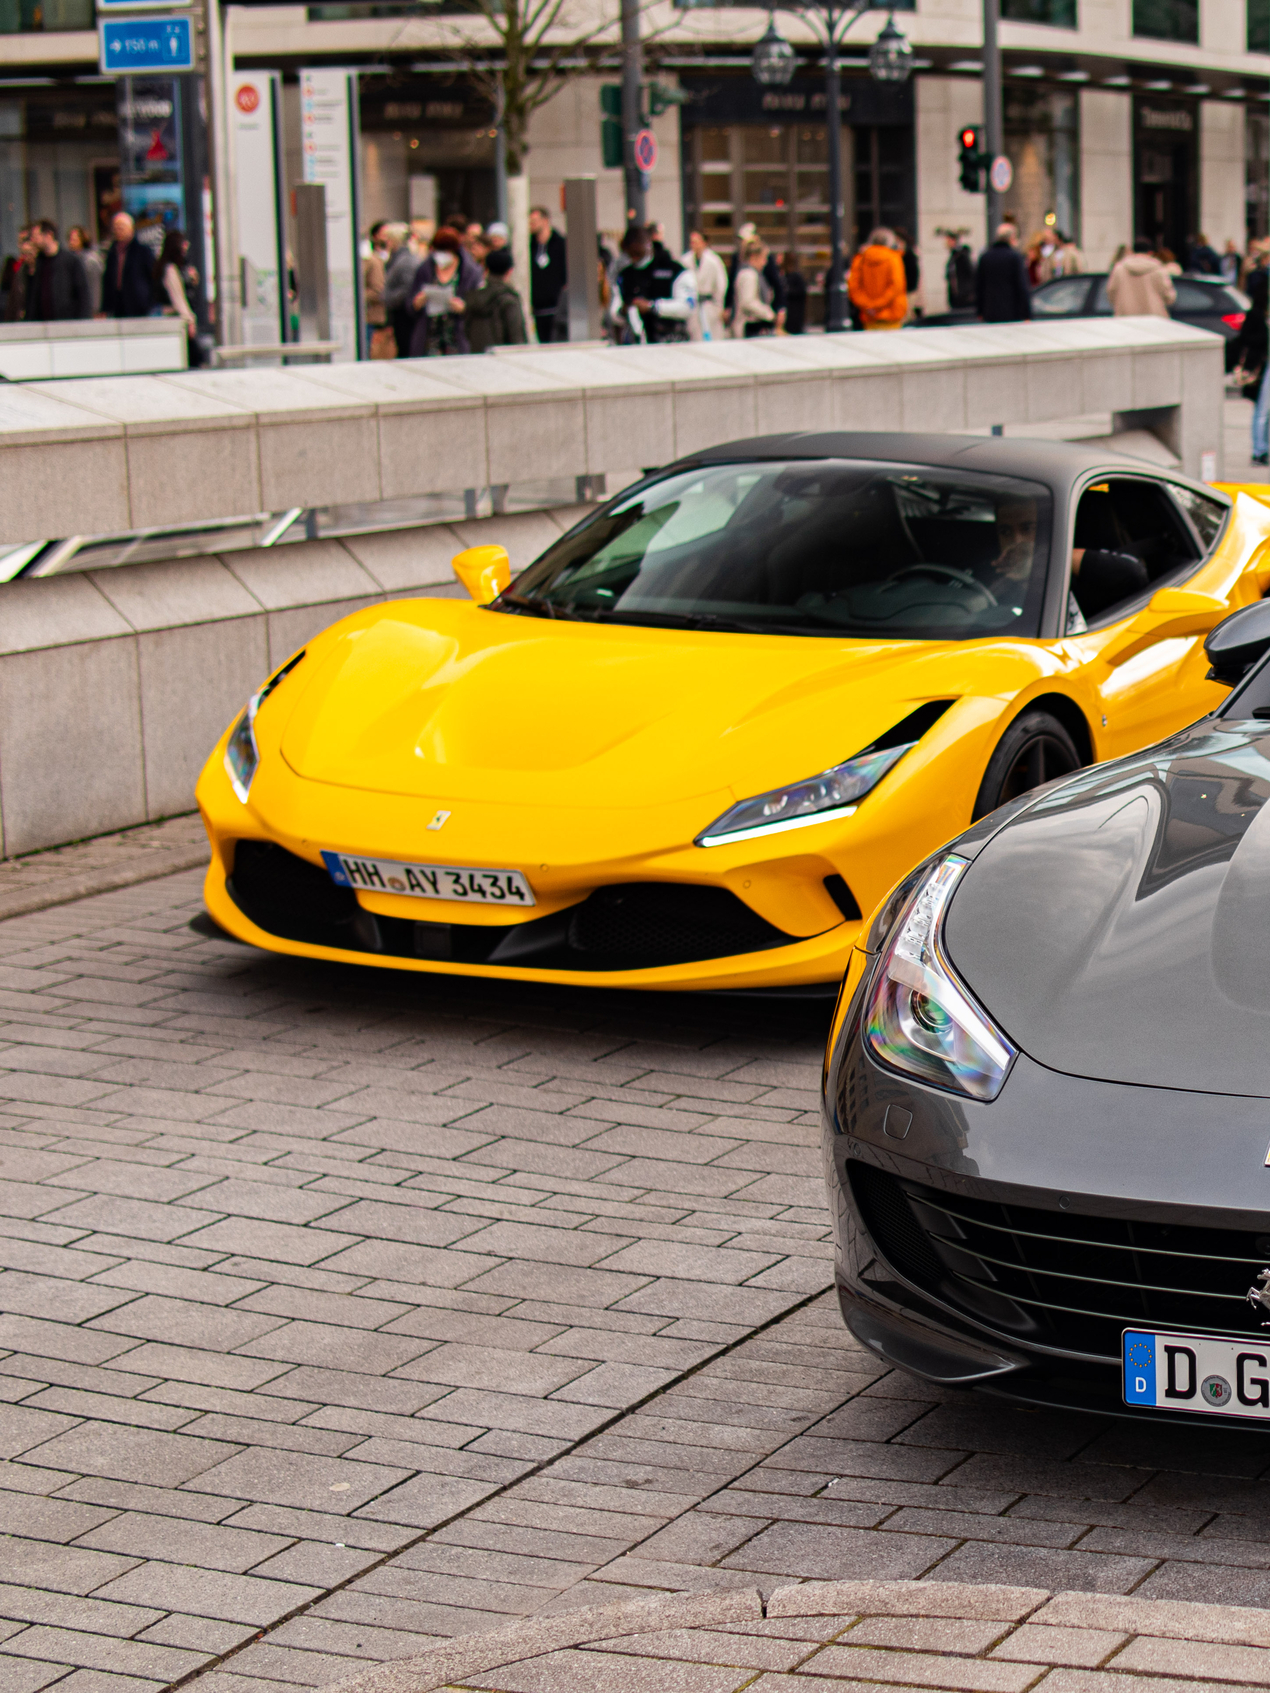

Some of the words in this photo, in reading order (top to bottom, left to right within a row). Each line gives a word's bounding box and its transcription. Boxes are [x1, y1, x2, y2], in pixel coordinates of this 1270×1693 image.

[343, 858, 386, 888] HH
[404, 867, 440, 895] AY
[445, 871, 525, 901] 3434
[1135, 1377, 1147, 1393] D
[1164, 1344, 1197, 1400] D
